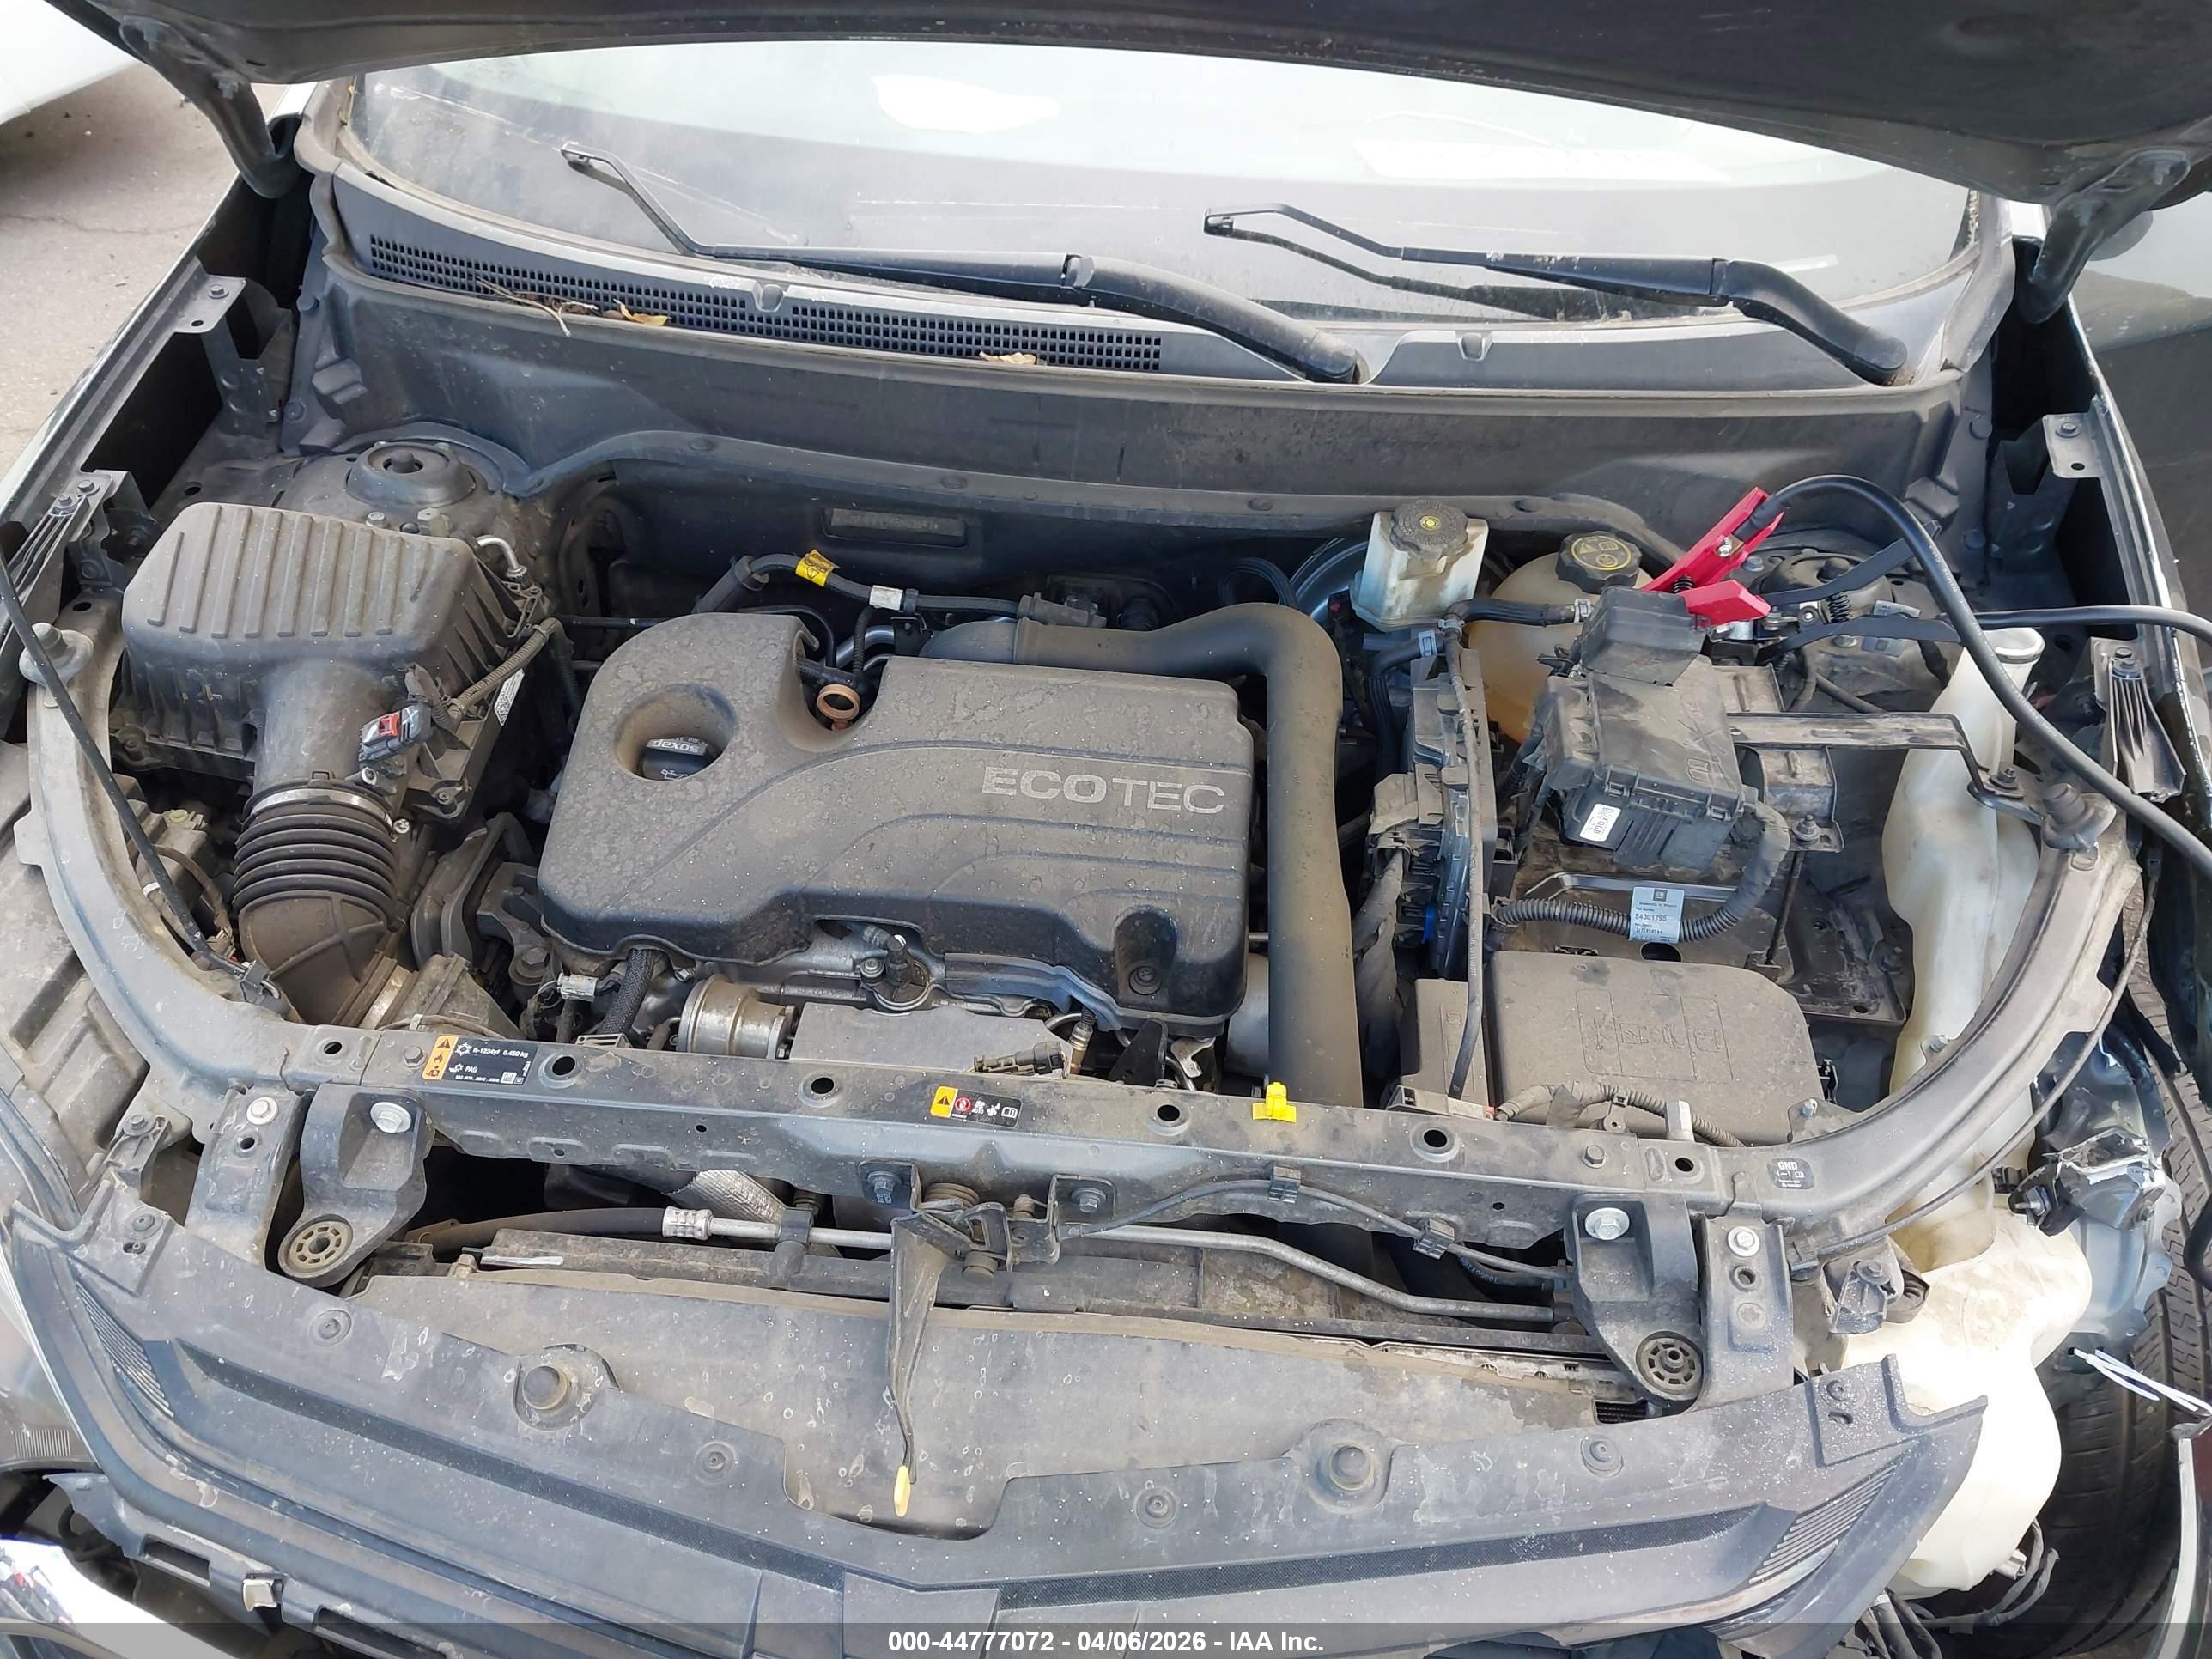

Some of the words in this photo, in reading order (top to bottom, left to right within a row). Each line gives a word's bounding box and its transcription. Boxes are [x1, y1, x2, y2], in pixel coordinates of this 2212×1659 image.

[653, 739, 699, 753] dexos
[981, 766, 1225, 814] ECOTEC
[473, 1047, 501, 1056] R-1234yf
[520, 1050, 529, 1059] kg
[1778, 1161, 1798, 1170] GND
